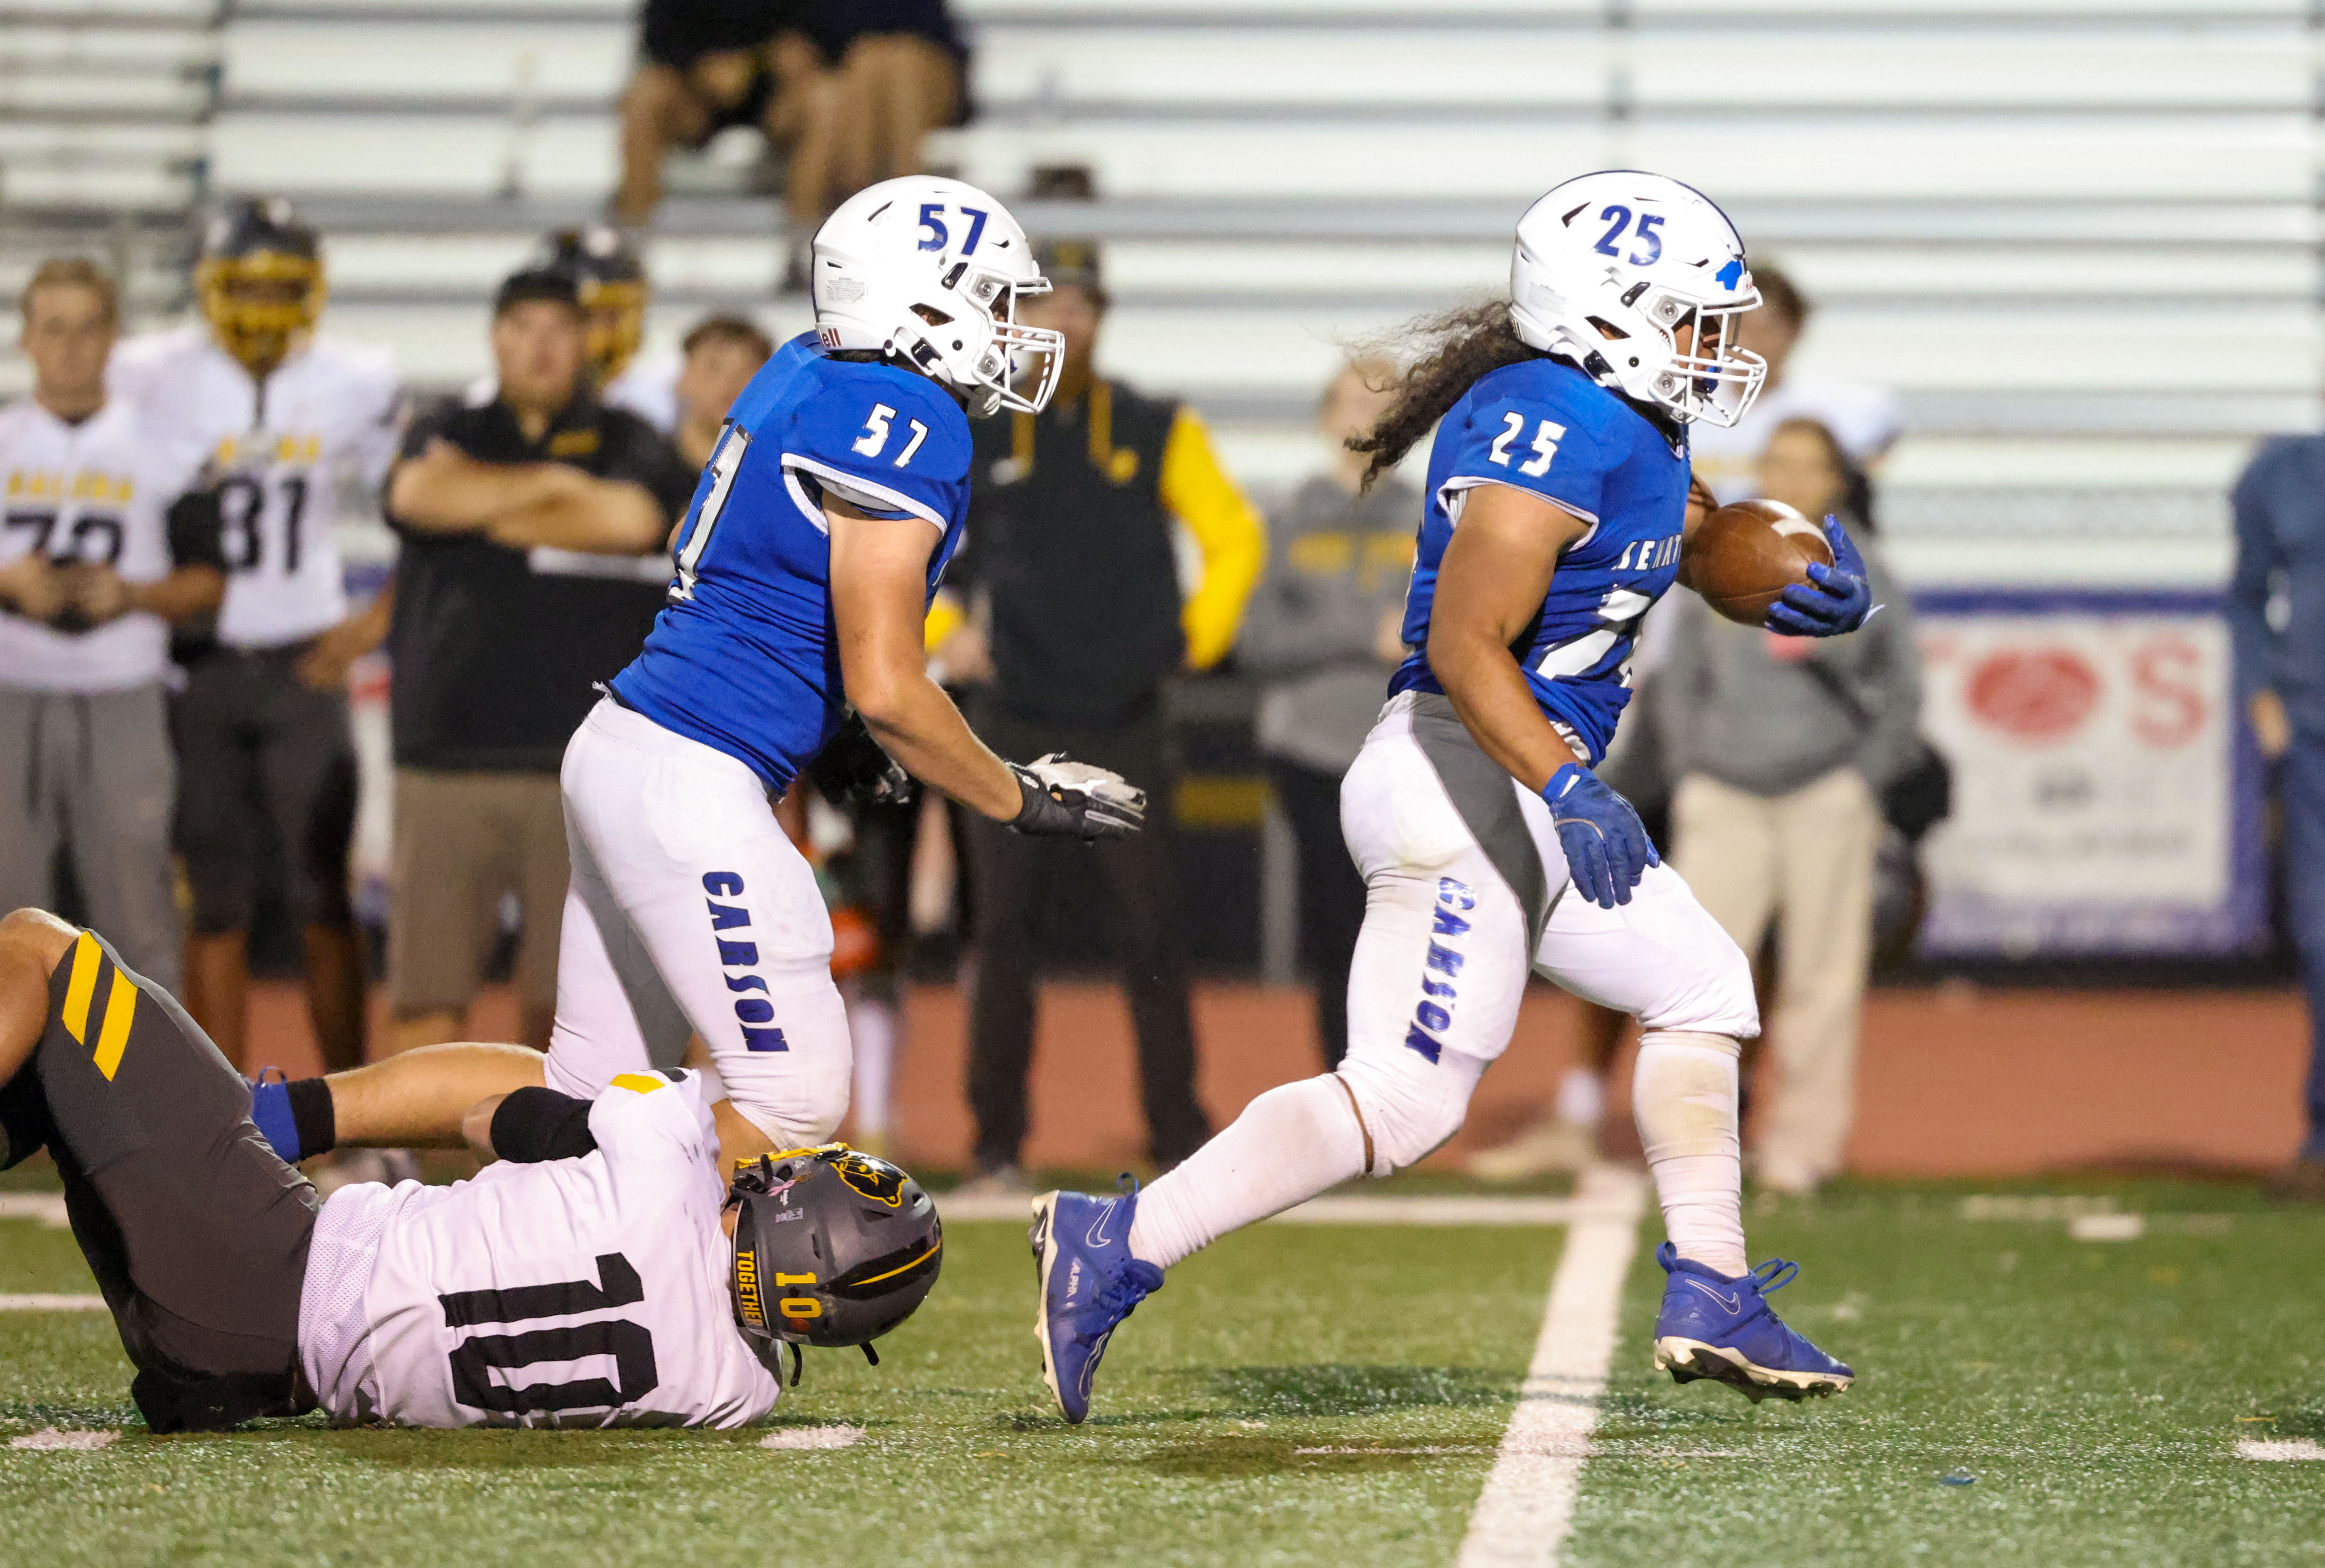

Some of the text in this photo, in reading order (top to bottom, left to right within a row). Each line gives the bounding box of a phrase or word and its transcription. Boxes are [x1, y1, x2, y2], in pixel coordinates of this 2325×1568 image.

[918, 204, 989, 256] 57
[1594, 205, 1666, 266] 25
[851, 402, 929, 468] 57
[1488, 411, 1567, 477] 25
[702, 871, 790, 1052] CARSON
[1404, 876, 1478, 1066] CARSON
[737, 1250, 764, 1326] TOGETHER
[775, 1272, 822, 1318] 10
[437, 1252, 659, 1416] 10
